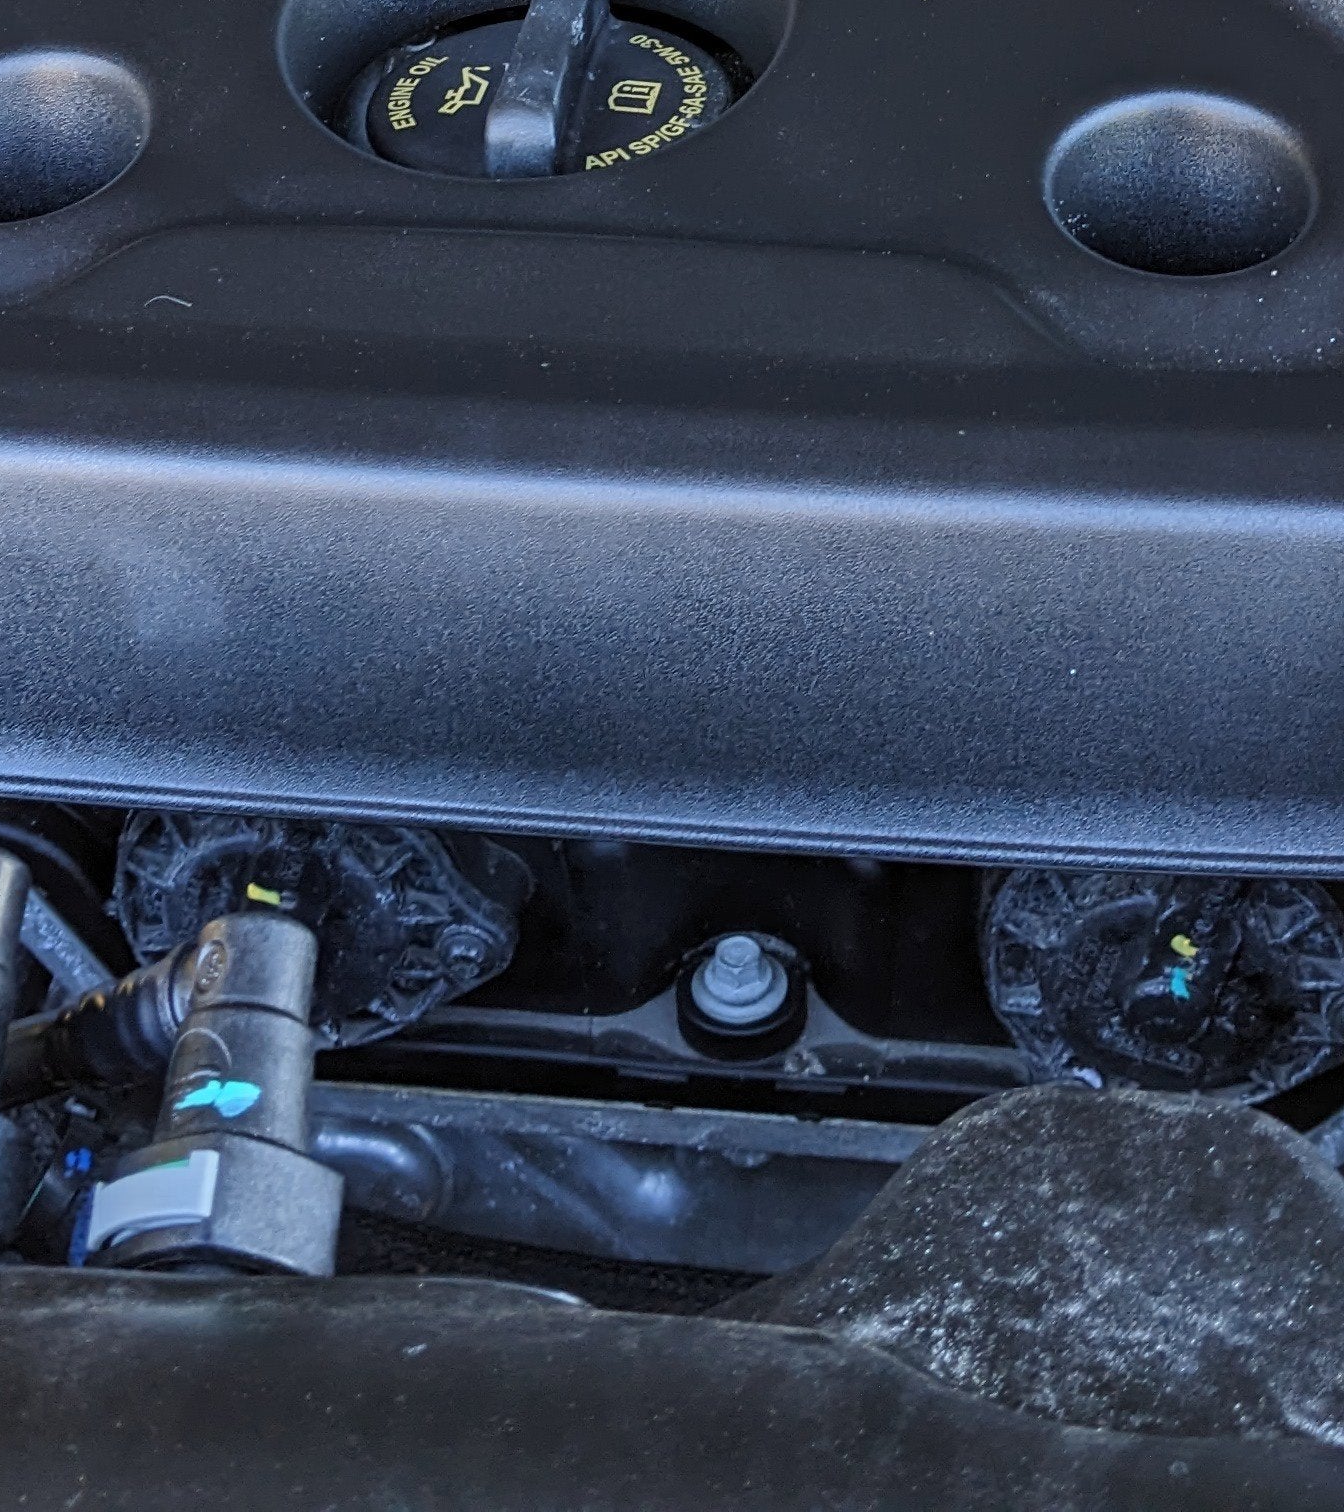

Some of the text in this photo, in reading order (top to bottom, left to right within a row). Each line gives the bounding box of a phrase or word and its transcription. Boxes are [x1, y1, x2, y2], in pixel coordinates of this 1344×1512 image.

[388, 55, 449, 131] ENGINE OIL
[585, 147, 632, 171] API
[628, 34, 691, 66] 5W-30
